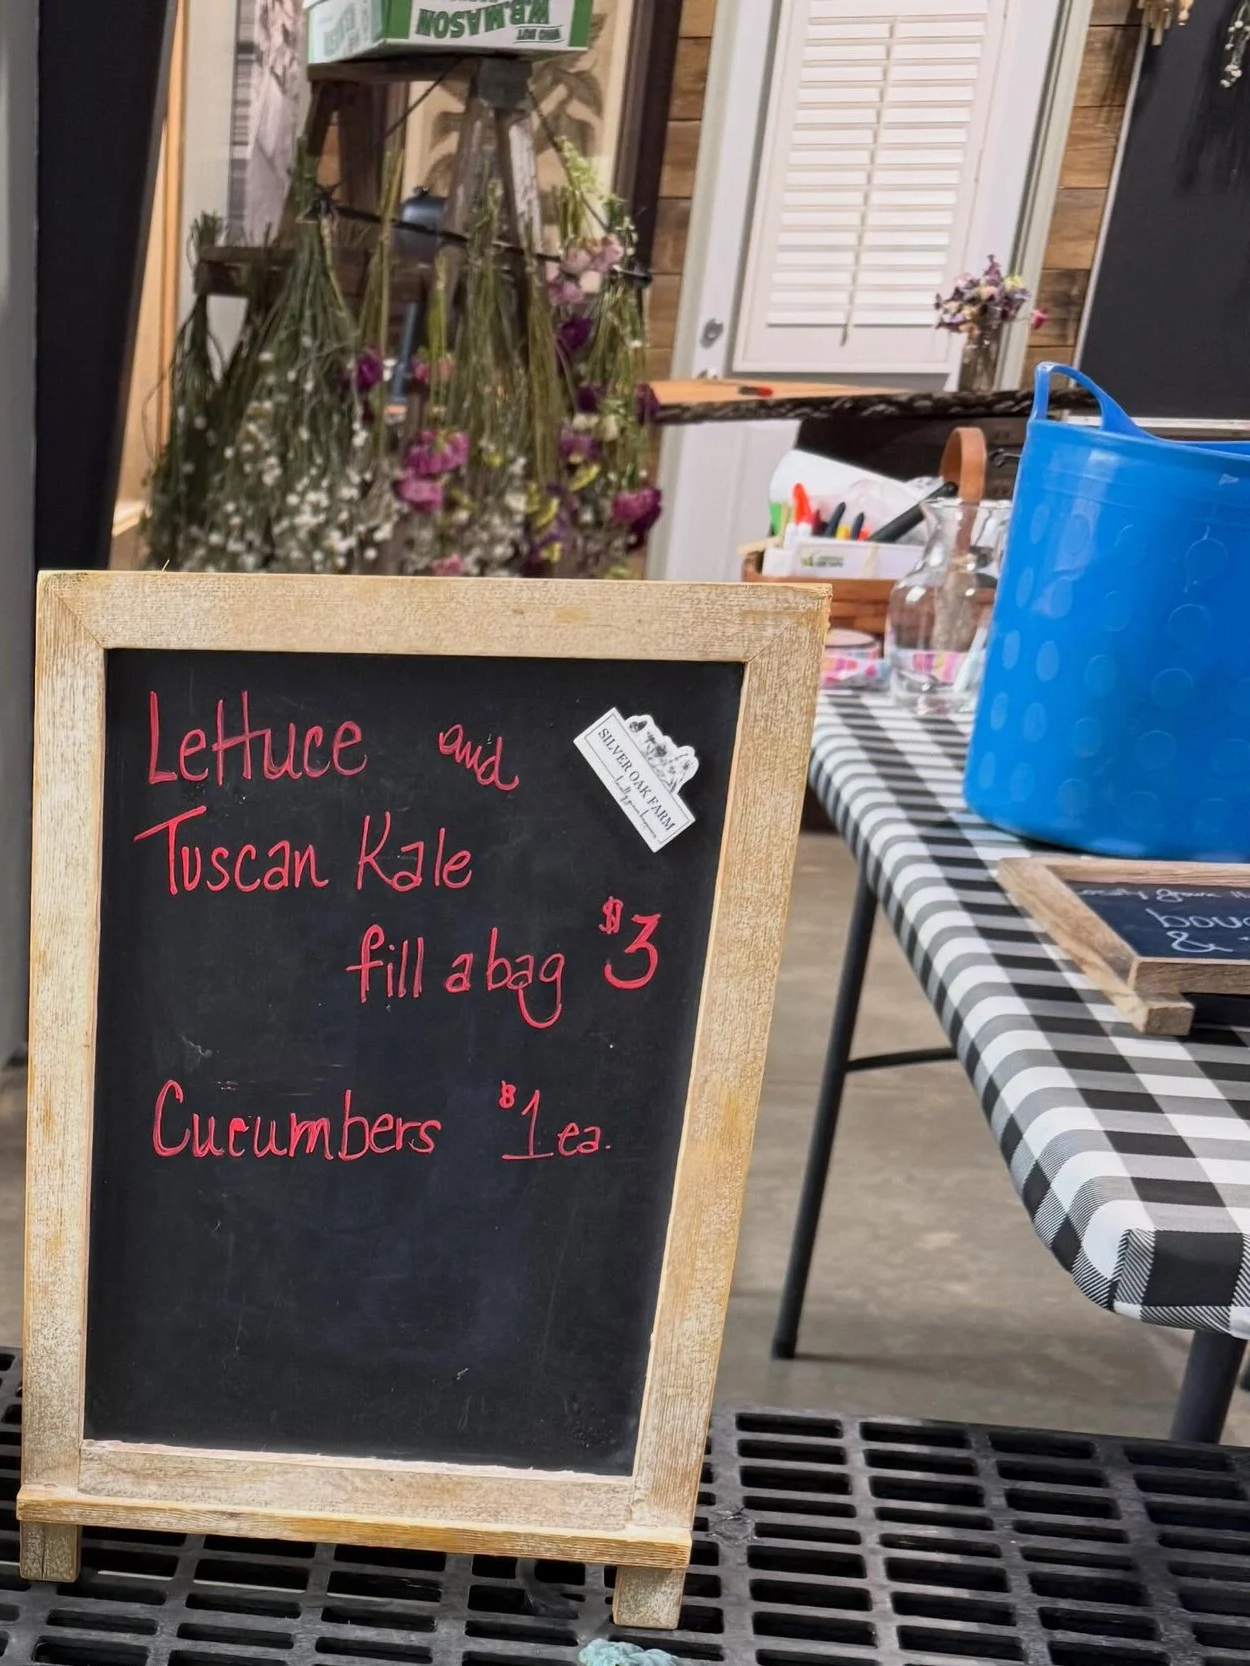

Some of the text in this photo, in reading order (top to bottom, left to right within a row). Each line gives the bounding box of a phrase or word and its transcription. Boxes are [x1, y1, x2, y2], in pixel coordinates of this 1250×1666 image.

[415, 3, 506, 39] MASON
[148, 690, 520, 790] Lettuce and
[598, 727, 633, 773] SILVER
[629, 770, 653, 801] OAK
[646, 796, 676, 832] FARM
[134, 804, 473, 895] Tuscan Kale
[345, 924, 426, 1003] fill
[598, 896, 662, 991] $3
[1165, 930, 1235, 953] &
[152, 1080, 443, 1162] Cucumbers
